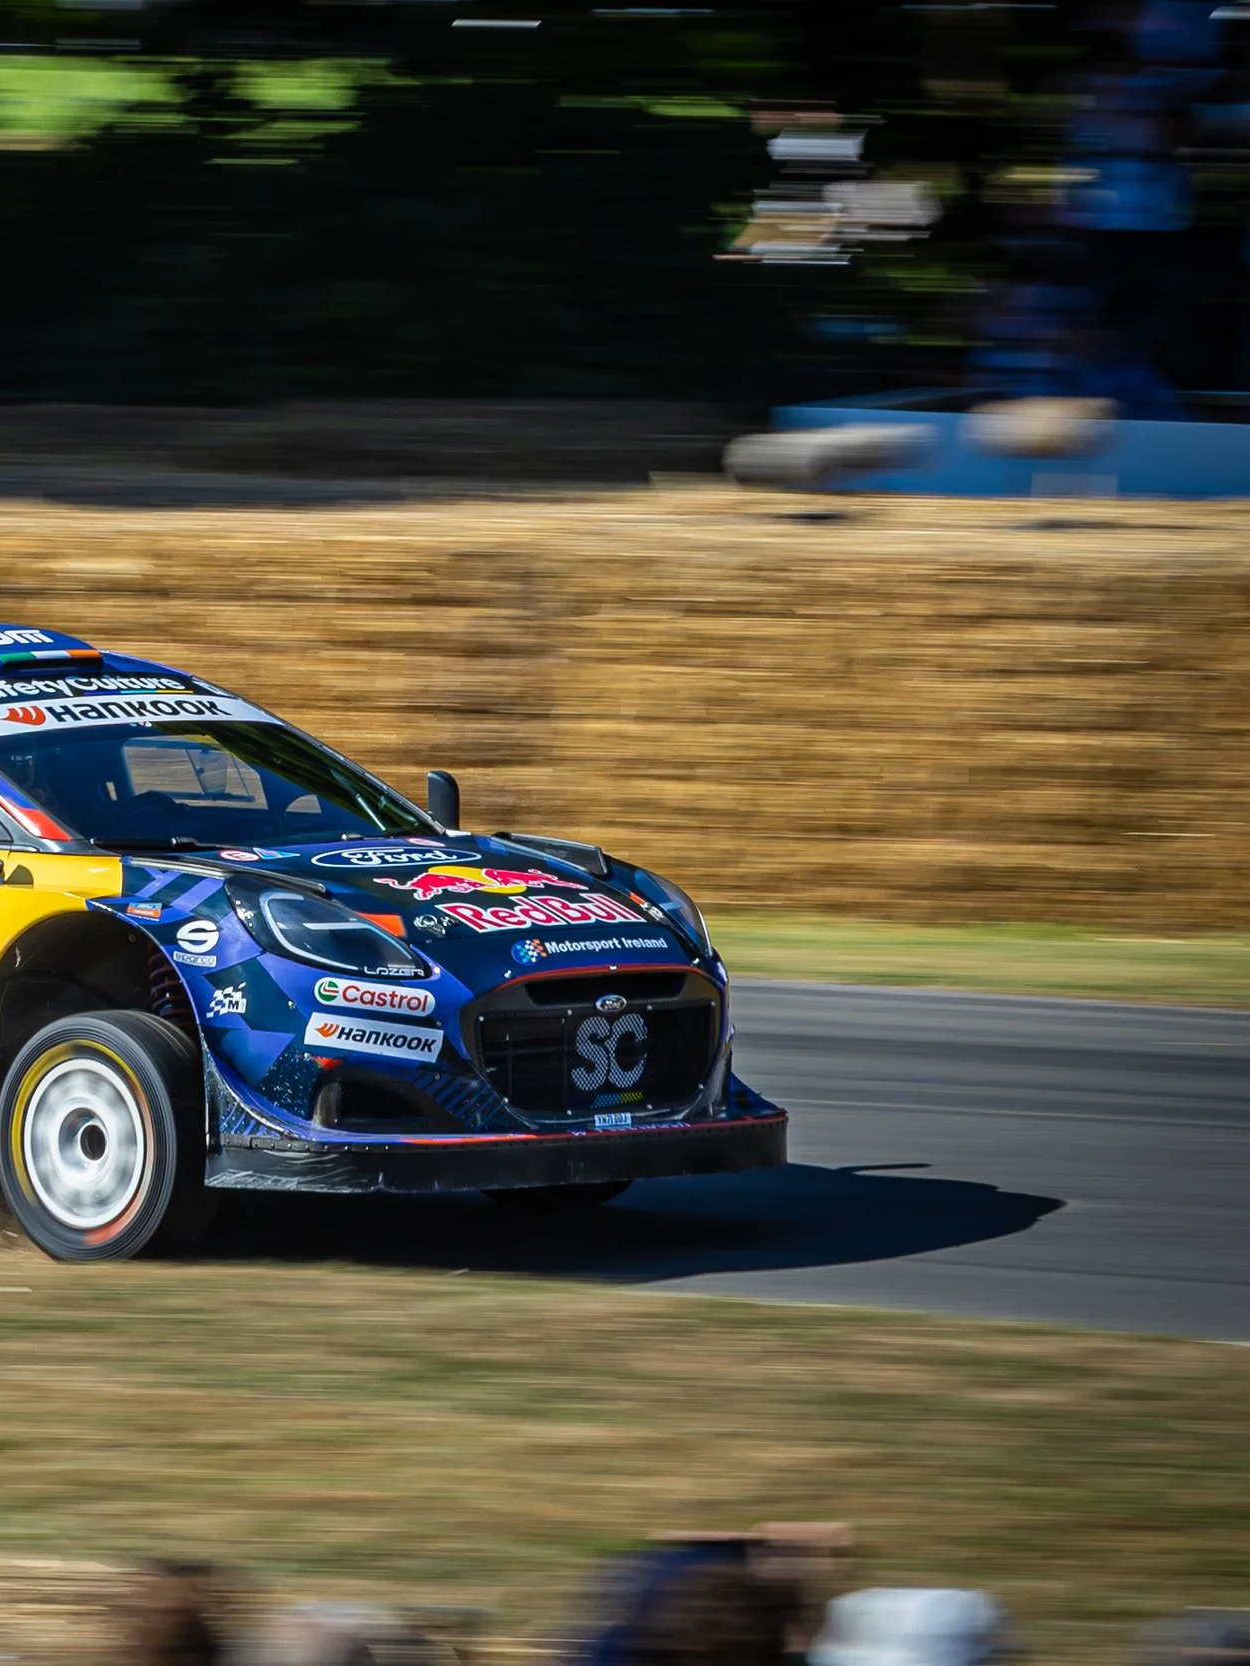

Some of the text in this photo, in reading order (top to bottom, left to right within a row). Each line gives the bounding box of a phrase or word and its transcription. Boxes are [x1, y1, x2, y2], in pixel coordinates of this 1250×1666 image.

[342, 849, 458, 864] Ford
[545, 937, 668, 954] Motorsport Ireland
[175, 953, 215, 966] sparco
[342, 985, 429, 1012] Castrol
[571, 1013, 648, 1091] SC
